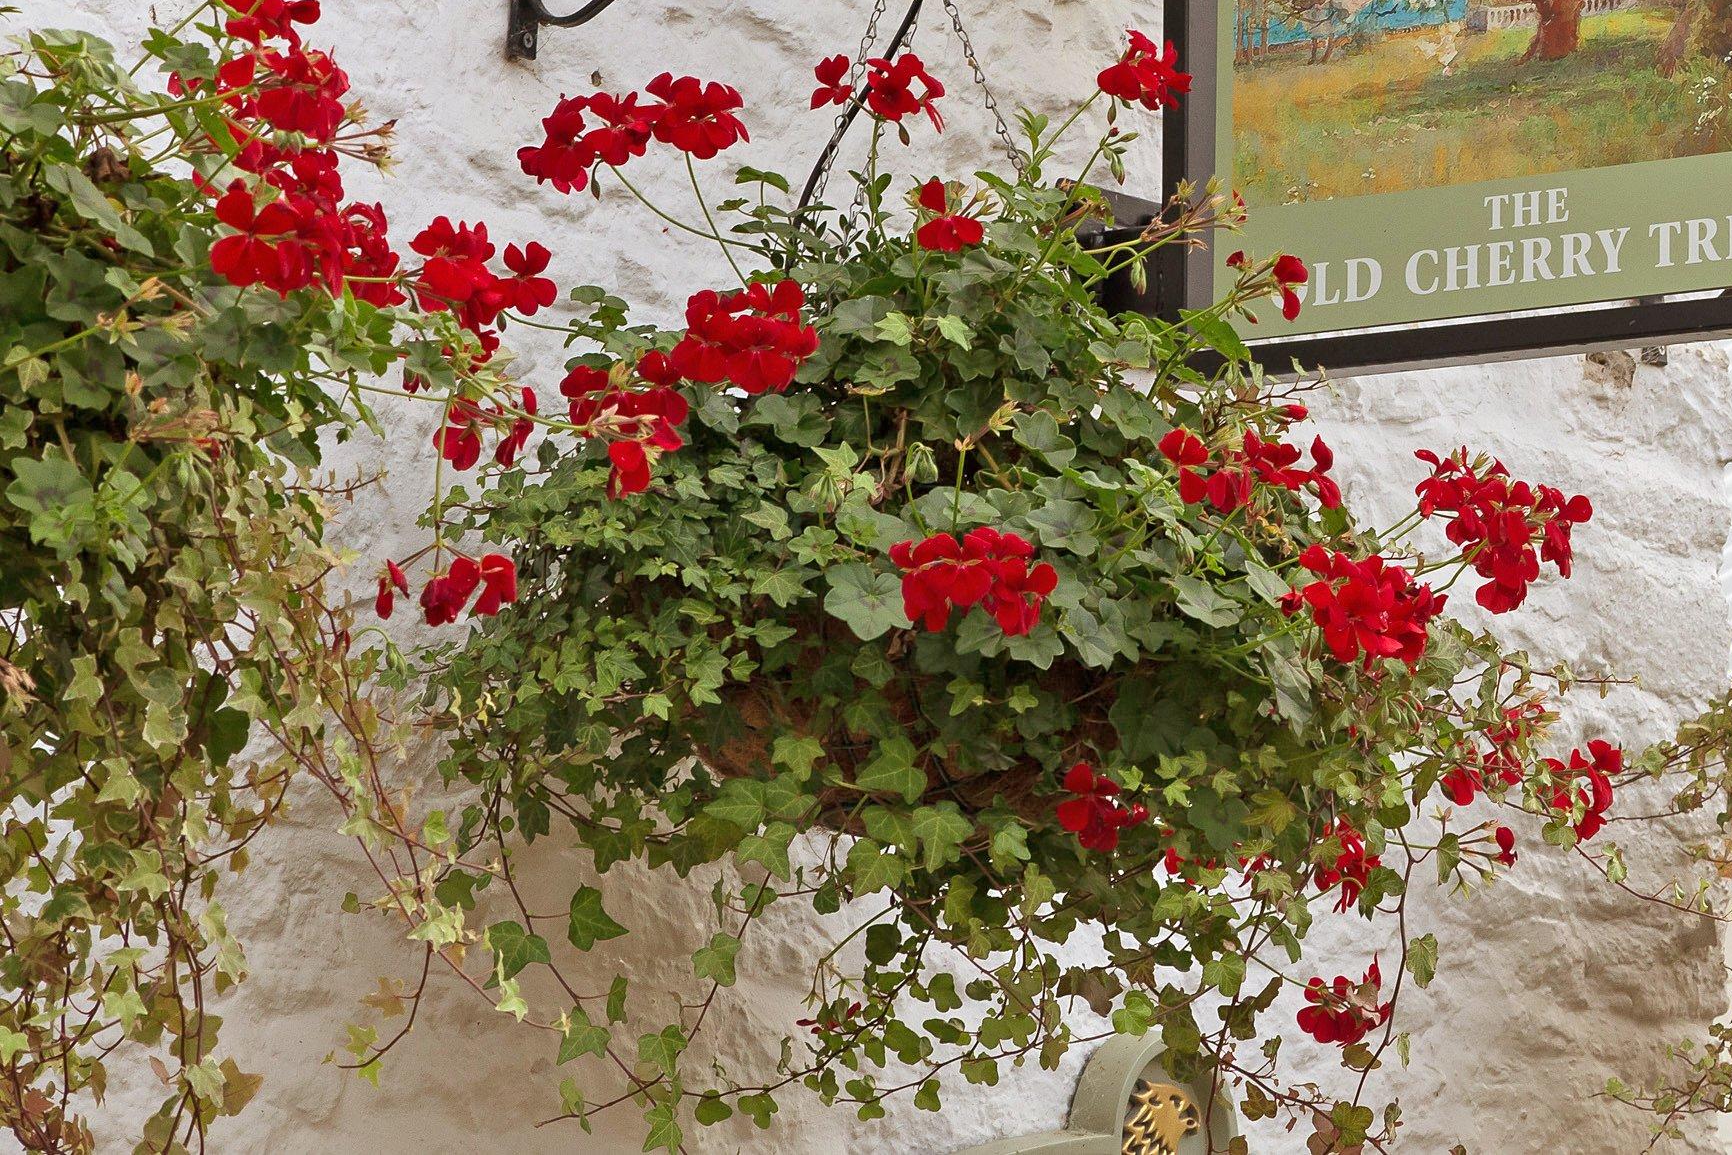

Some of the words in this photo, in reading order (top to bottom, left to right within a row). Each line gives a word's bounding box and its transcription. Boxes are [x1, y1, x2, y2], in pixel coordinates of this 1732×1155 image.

[1484, 187, 1570, 231] THE
[1271, 257, 1383, 310] LD
[1404, 227, 1631, 295] CHERRY
